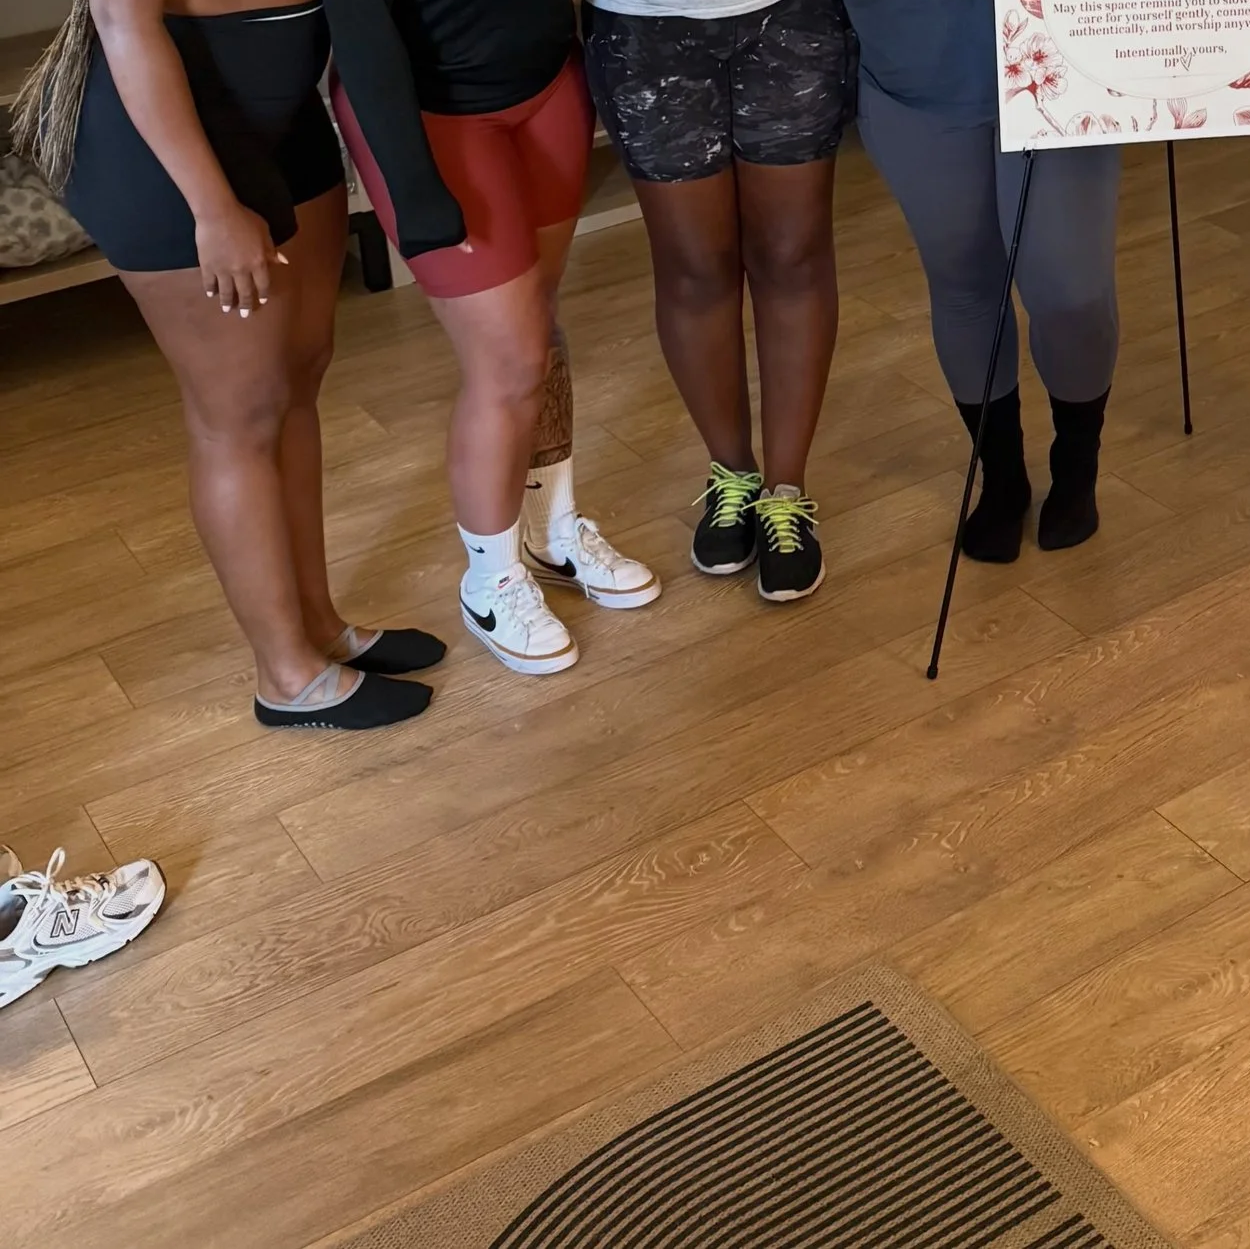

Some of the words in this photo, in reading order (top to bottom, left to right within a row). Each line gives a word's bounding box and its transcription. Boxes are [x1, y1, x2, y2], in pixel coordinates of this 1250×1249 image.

[1053, 3, 1077, 15] May
[1080, 1, 1102, 12] this
[1105, 2, 1137, 13] space
[1077, 15, 1103, 25] care
[1105, 13, 1123, 23] for
[1125, 10, 1173, 24] yourself
[1175, 8, 1214, 21] gently,
[1069, 23, 1149, 37] authentically,
[1151, 21, 1172, 33] and
[1175, 19, 1221, 32] worship
[1115, 44, 1189, 59] Intentionally
[1191, 45, 1227, 58] yours,
[1164, 58, 1180, 68] DP
[50, 909, 80, 938] N
